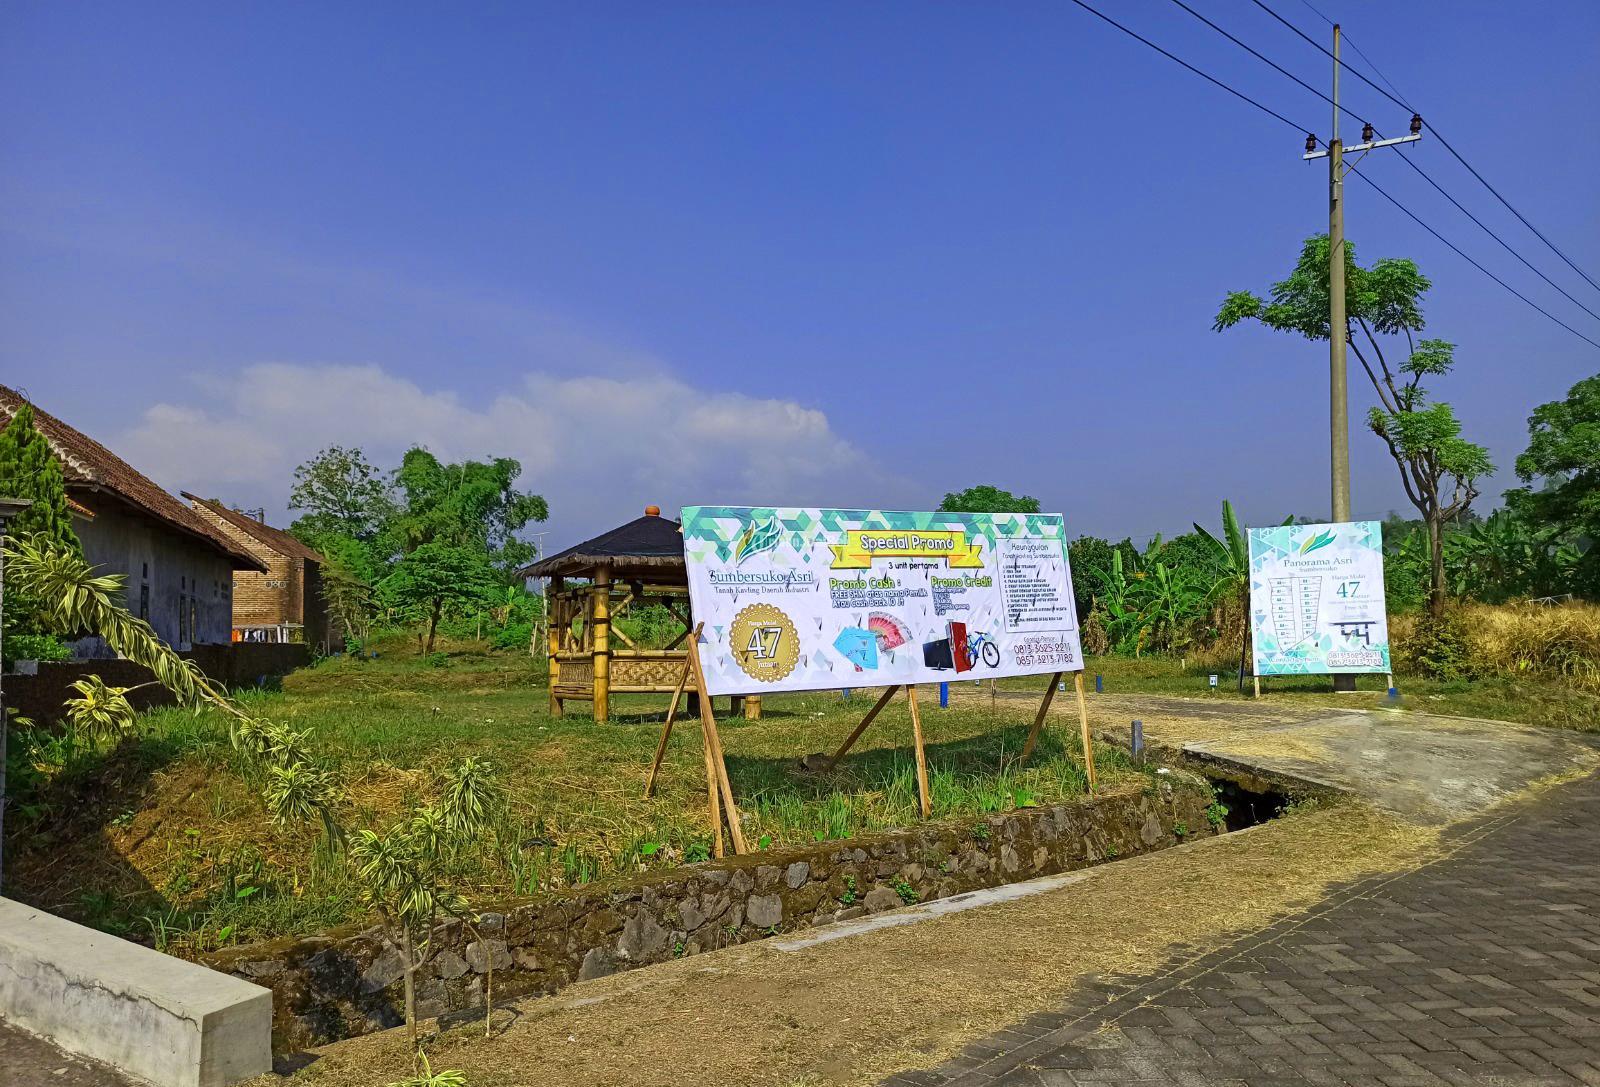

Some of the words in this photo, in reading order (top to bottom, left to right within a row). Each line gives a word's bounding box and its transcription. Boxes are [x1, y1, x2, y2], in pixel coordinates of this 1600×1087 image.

[860, 534, 908, 552] Special
[911, 535, 954, 549] Promo
[888, 561, 893, 569] 3
[909, 562, 939, 570] pertama
[1284, 559, 1330, 567] Panorama
[1332, 557, 1353, 565] Asri
[709, 569, 785, 583] Sumbersuko
[786, 568, 813, 582] Asri
[931, 576, 963, 587] Promo
[964, 576, 993, 587] Credit
[829, 577, 867, 589] Promo
[869, 577, 895, 589] Cash
[831, 590, 848, 599] FREE
[867, 590, 883, 598] atas
[1336, 581, 1361, 598] 47
[747, 627, 782, 659] 47
